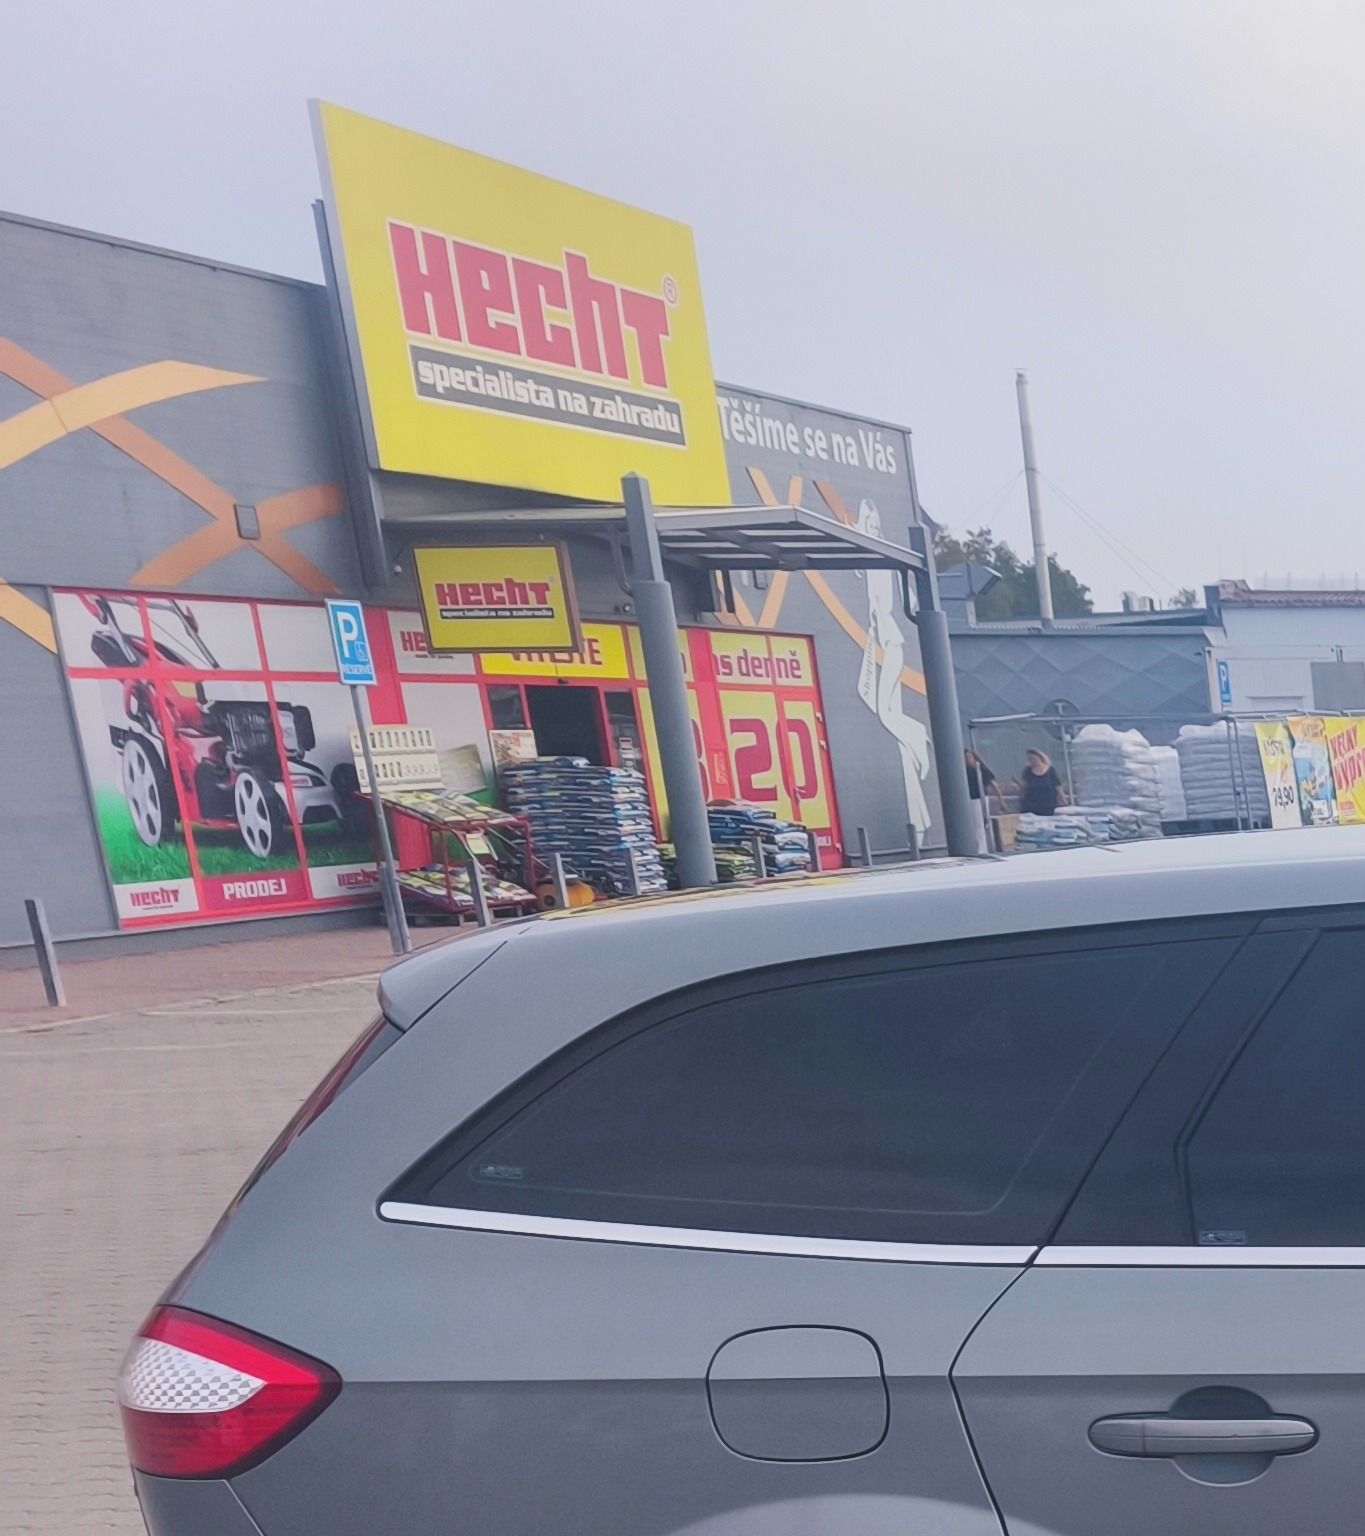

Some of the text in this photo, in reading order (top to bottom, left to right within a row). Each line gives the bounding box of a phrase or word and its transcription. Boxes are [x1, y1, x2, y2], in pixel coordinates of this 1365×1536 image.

[417, 359, 682, 434] specialista na zahradu
[717, 396, 897, 474] Těšíme se na Vás
[337, 611, 358, 658] P
[737, 648, 802, 679] denně
[729, 718, 818, 802] 20
[223, 878, 287, 900] PRODEJ
